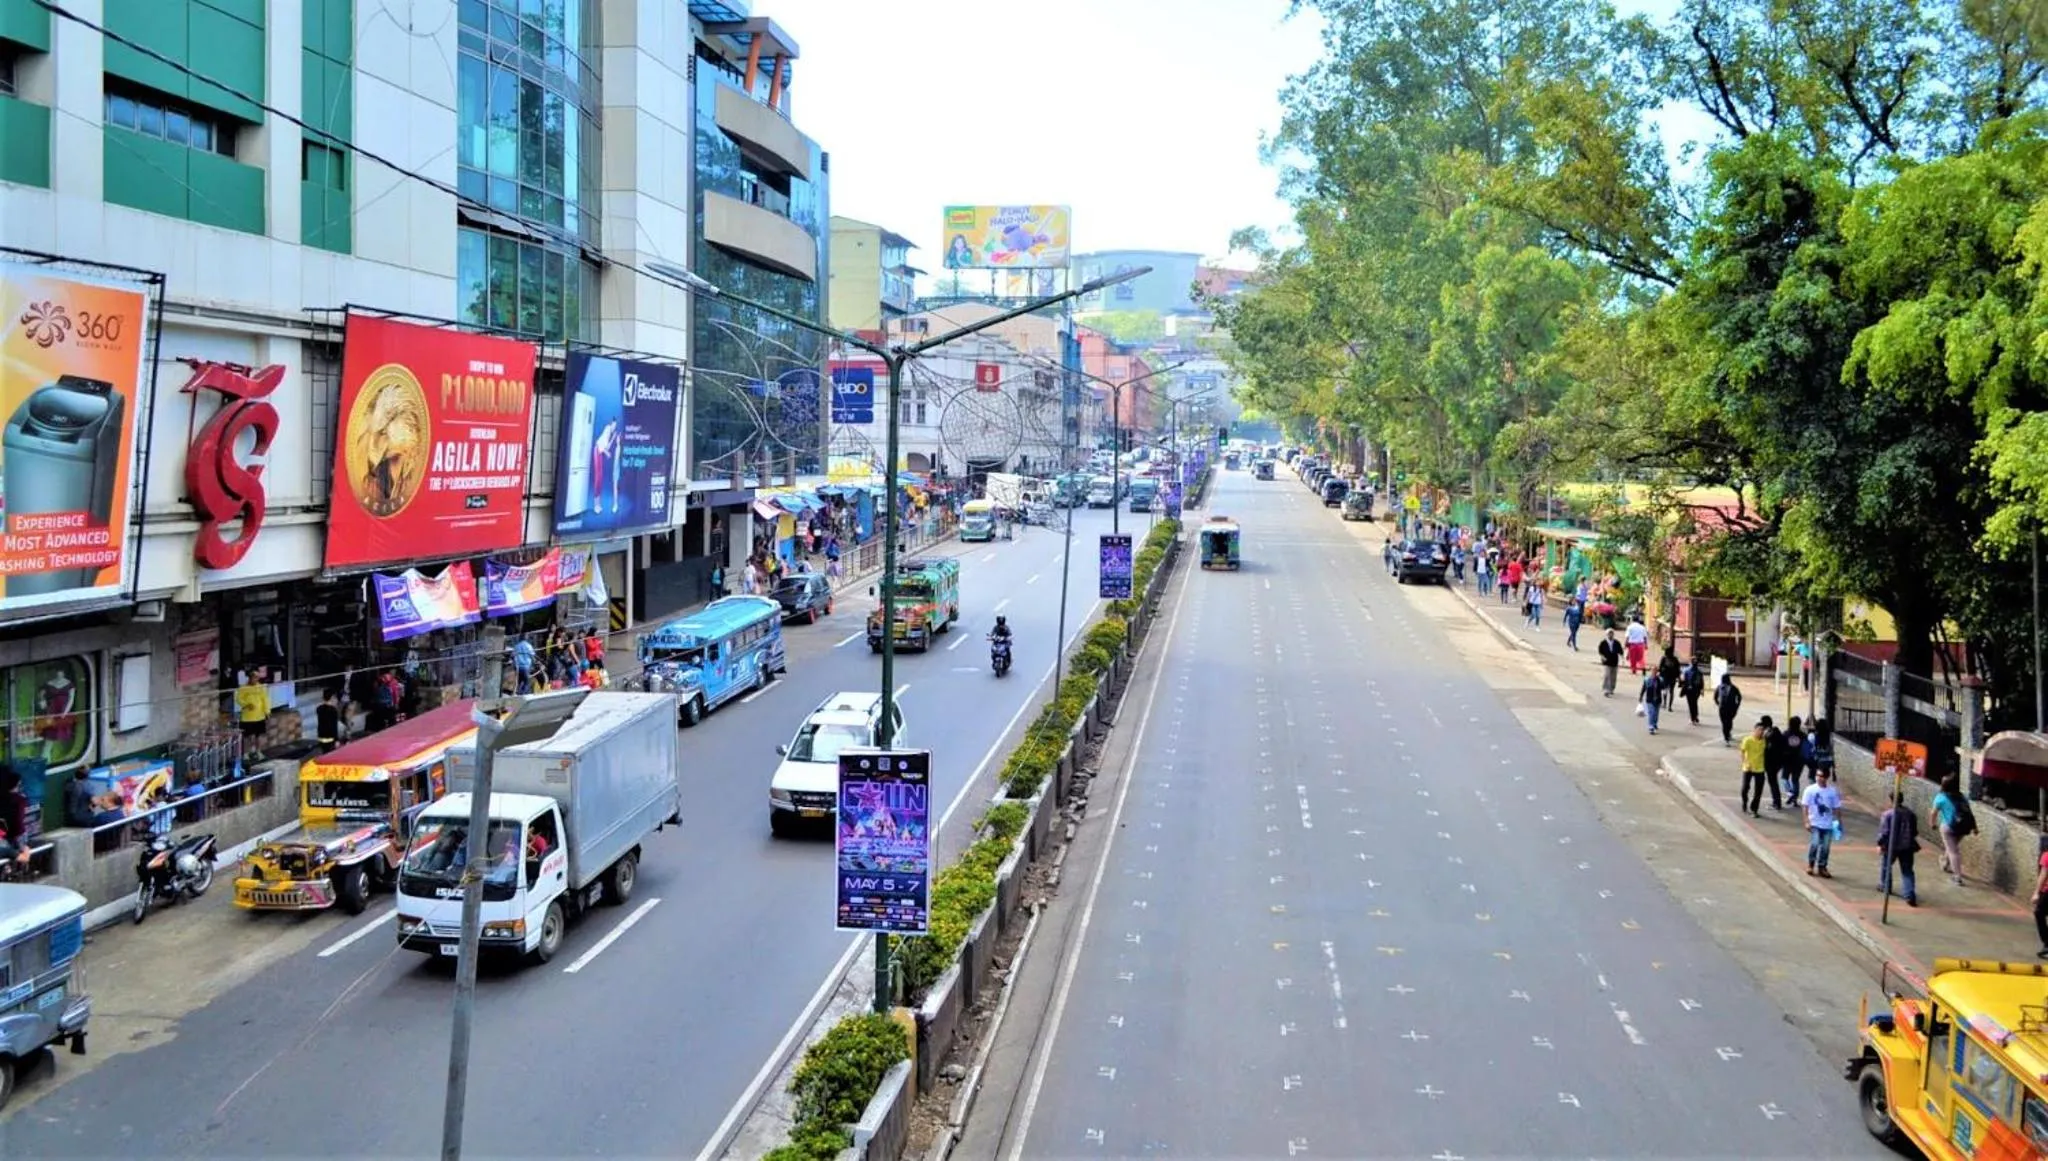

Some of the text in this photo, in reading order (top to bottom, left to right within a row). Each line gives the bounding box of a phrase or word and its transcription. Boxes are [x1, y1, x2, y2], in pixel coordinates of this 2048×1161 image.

[637, 382, 673, 402] Electrolux
[837, 383, 868, 394] BDO
[431, 441, 523, 472] AGILA NOW!
[16, 514, 85, 531] EXPERIENCE
[4, 531, 110, 552] MOST ADVANCED
[49, 550, 119, 567] TECHNOLOGY
[435, 887, 465, 897] ISUZ
[845, 877, 880, 890] MAY
[883, 879, 895, 891] 5
[907, 880, 920, 892] 7
